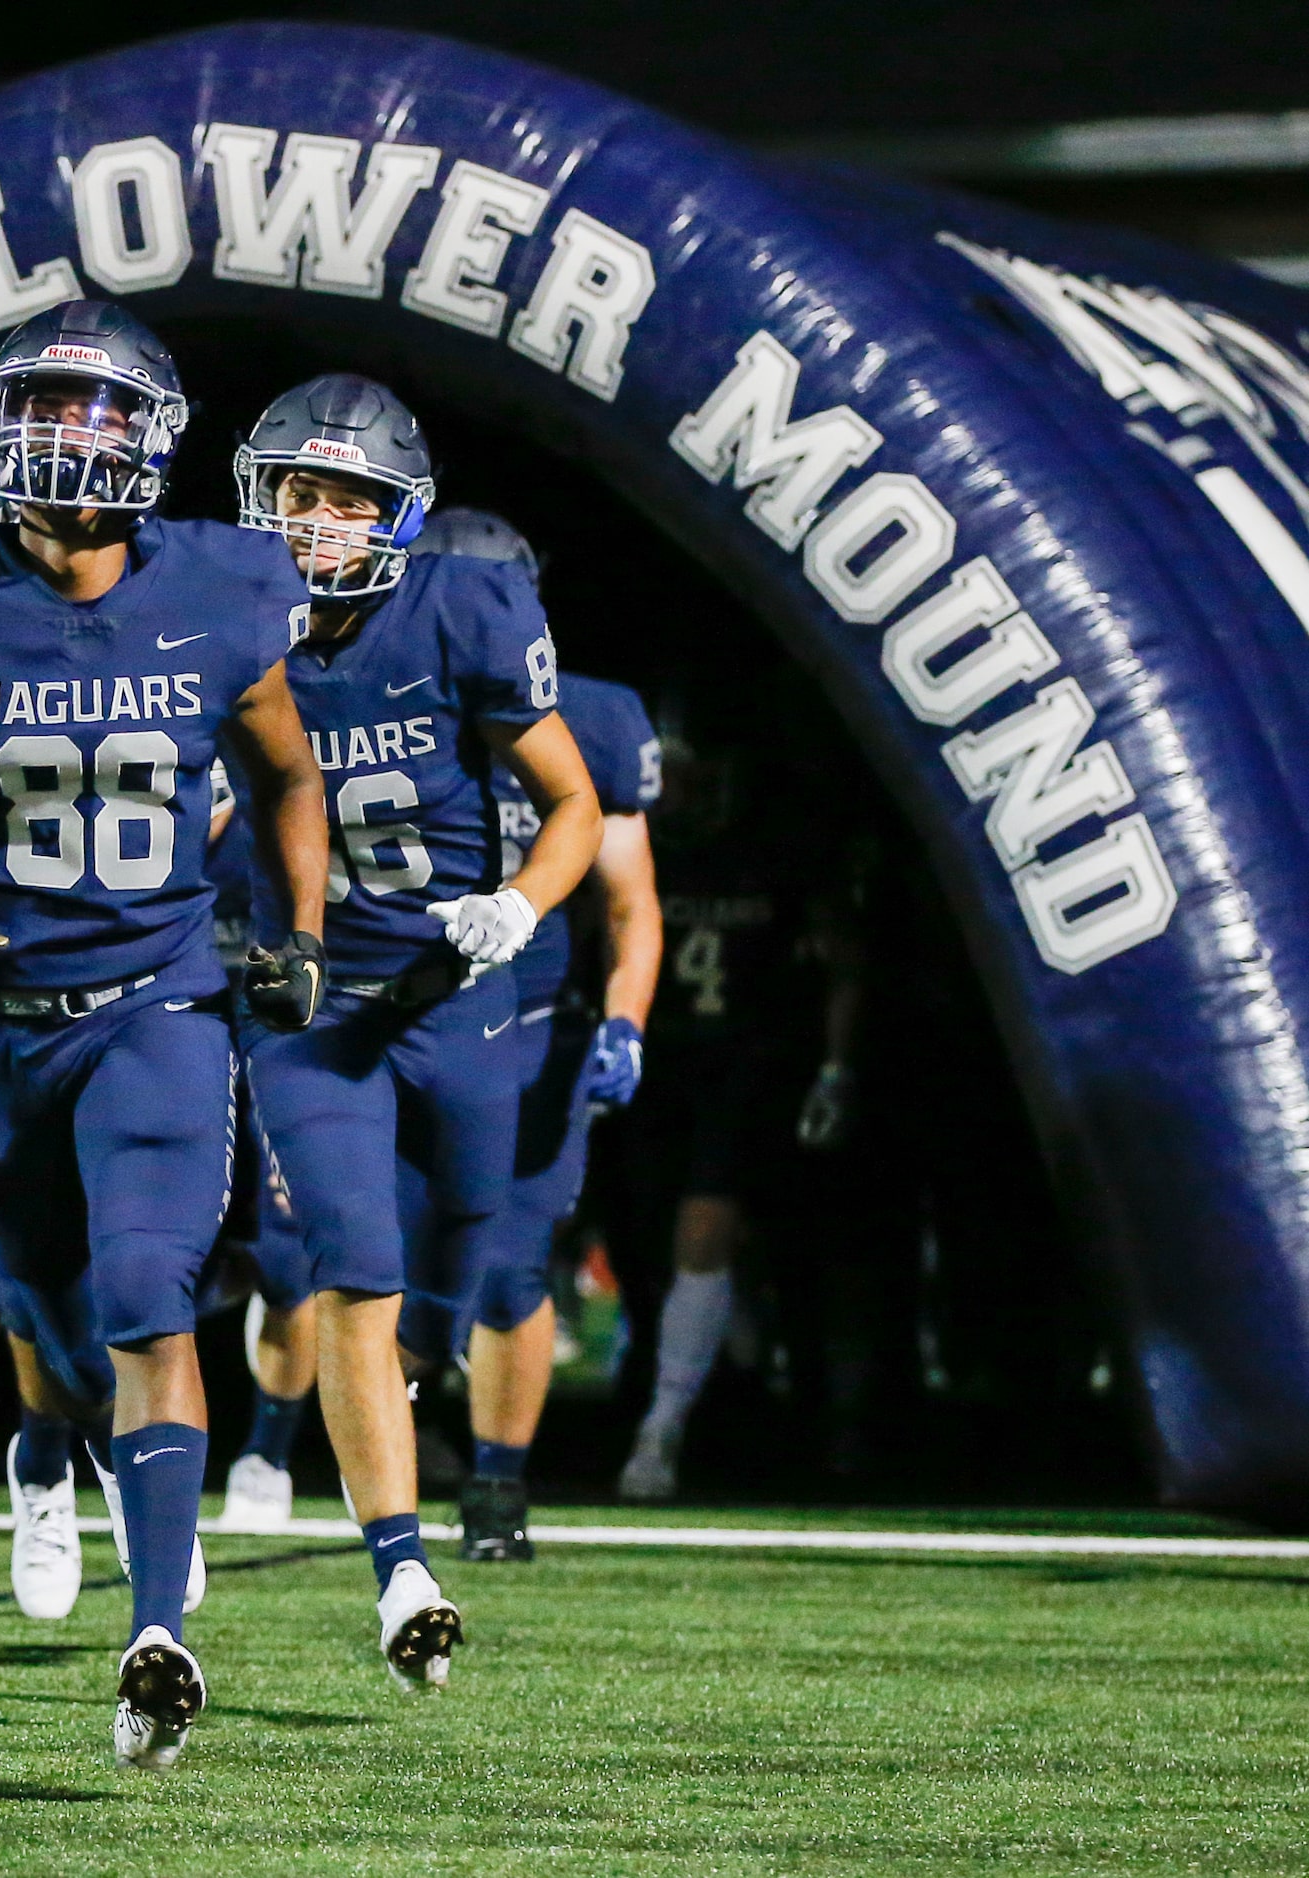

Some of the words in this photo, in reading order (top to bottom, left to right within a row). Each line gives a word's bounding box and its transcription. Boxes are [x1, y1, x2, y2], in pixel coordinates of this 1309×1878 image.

[47, 347, 104, 361] Riddell
[308, 441, 359, 460] Riddell
[668, 330, 1178, 976] MOUND
[304, 716, 437, 771] UARS
[322, 770, 434, 904] 6
